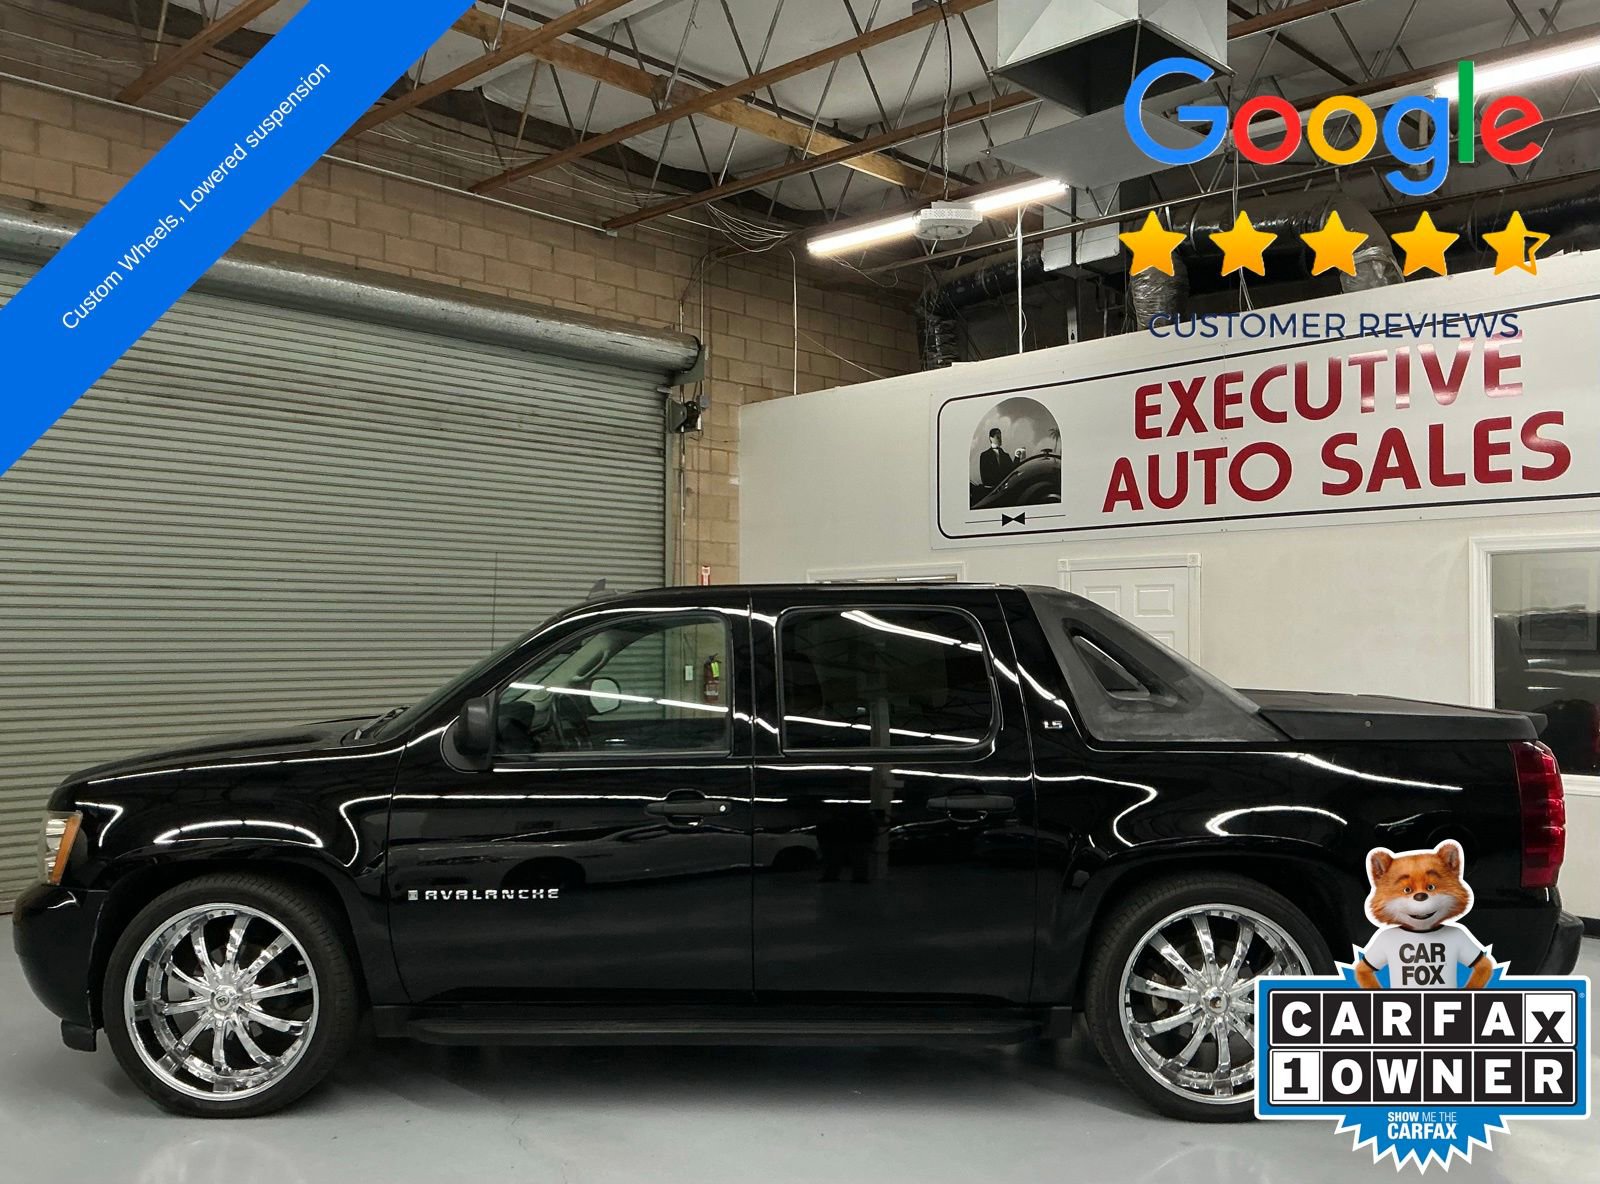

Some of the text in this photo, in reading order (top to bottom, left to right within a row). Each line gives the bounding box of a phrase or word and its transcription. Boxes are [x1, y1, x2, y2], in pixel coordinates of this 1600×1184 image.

[1134, 330, 1524, 441] EXECUTIVE
[1102, 411, 1573, 514] AUTO SALES
[424, 888, 560, 901] AVALANCHE
